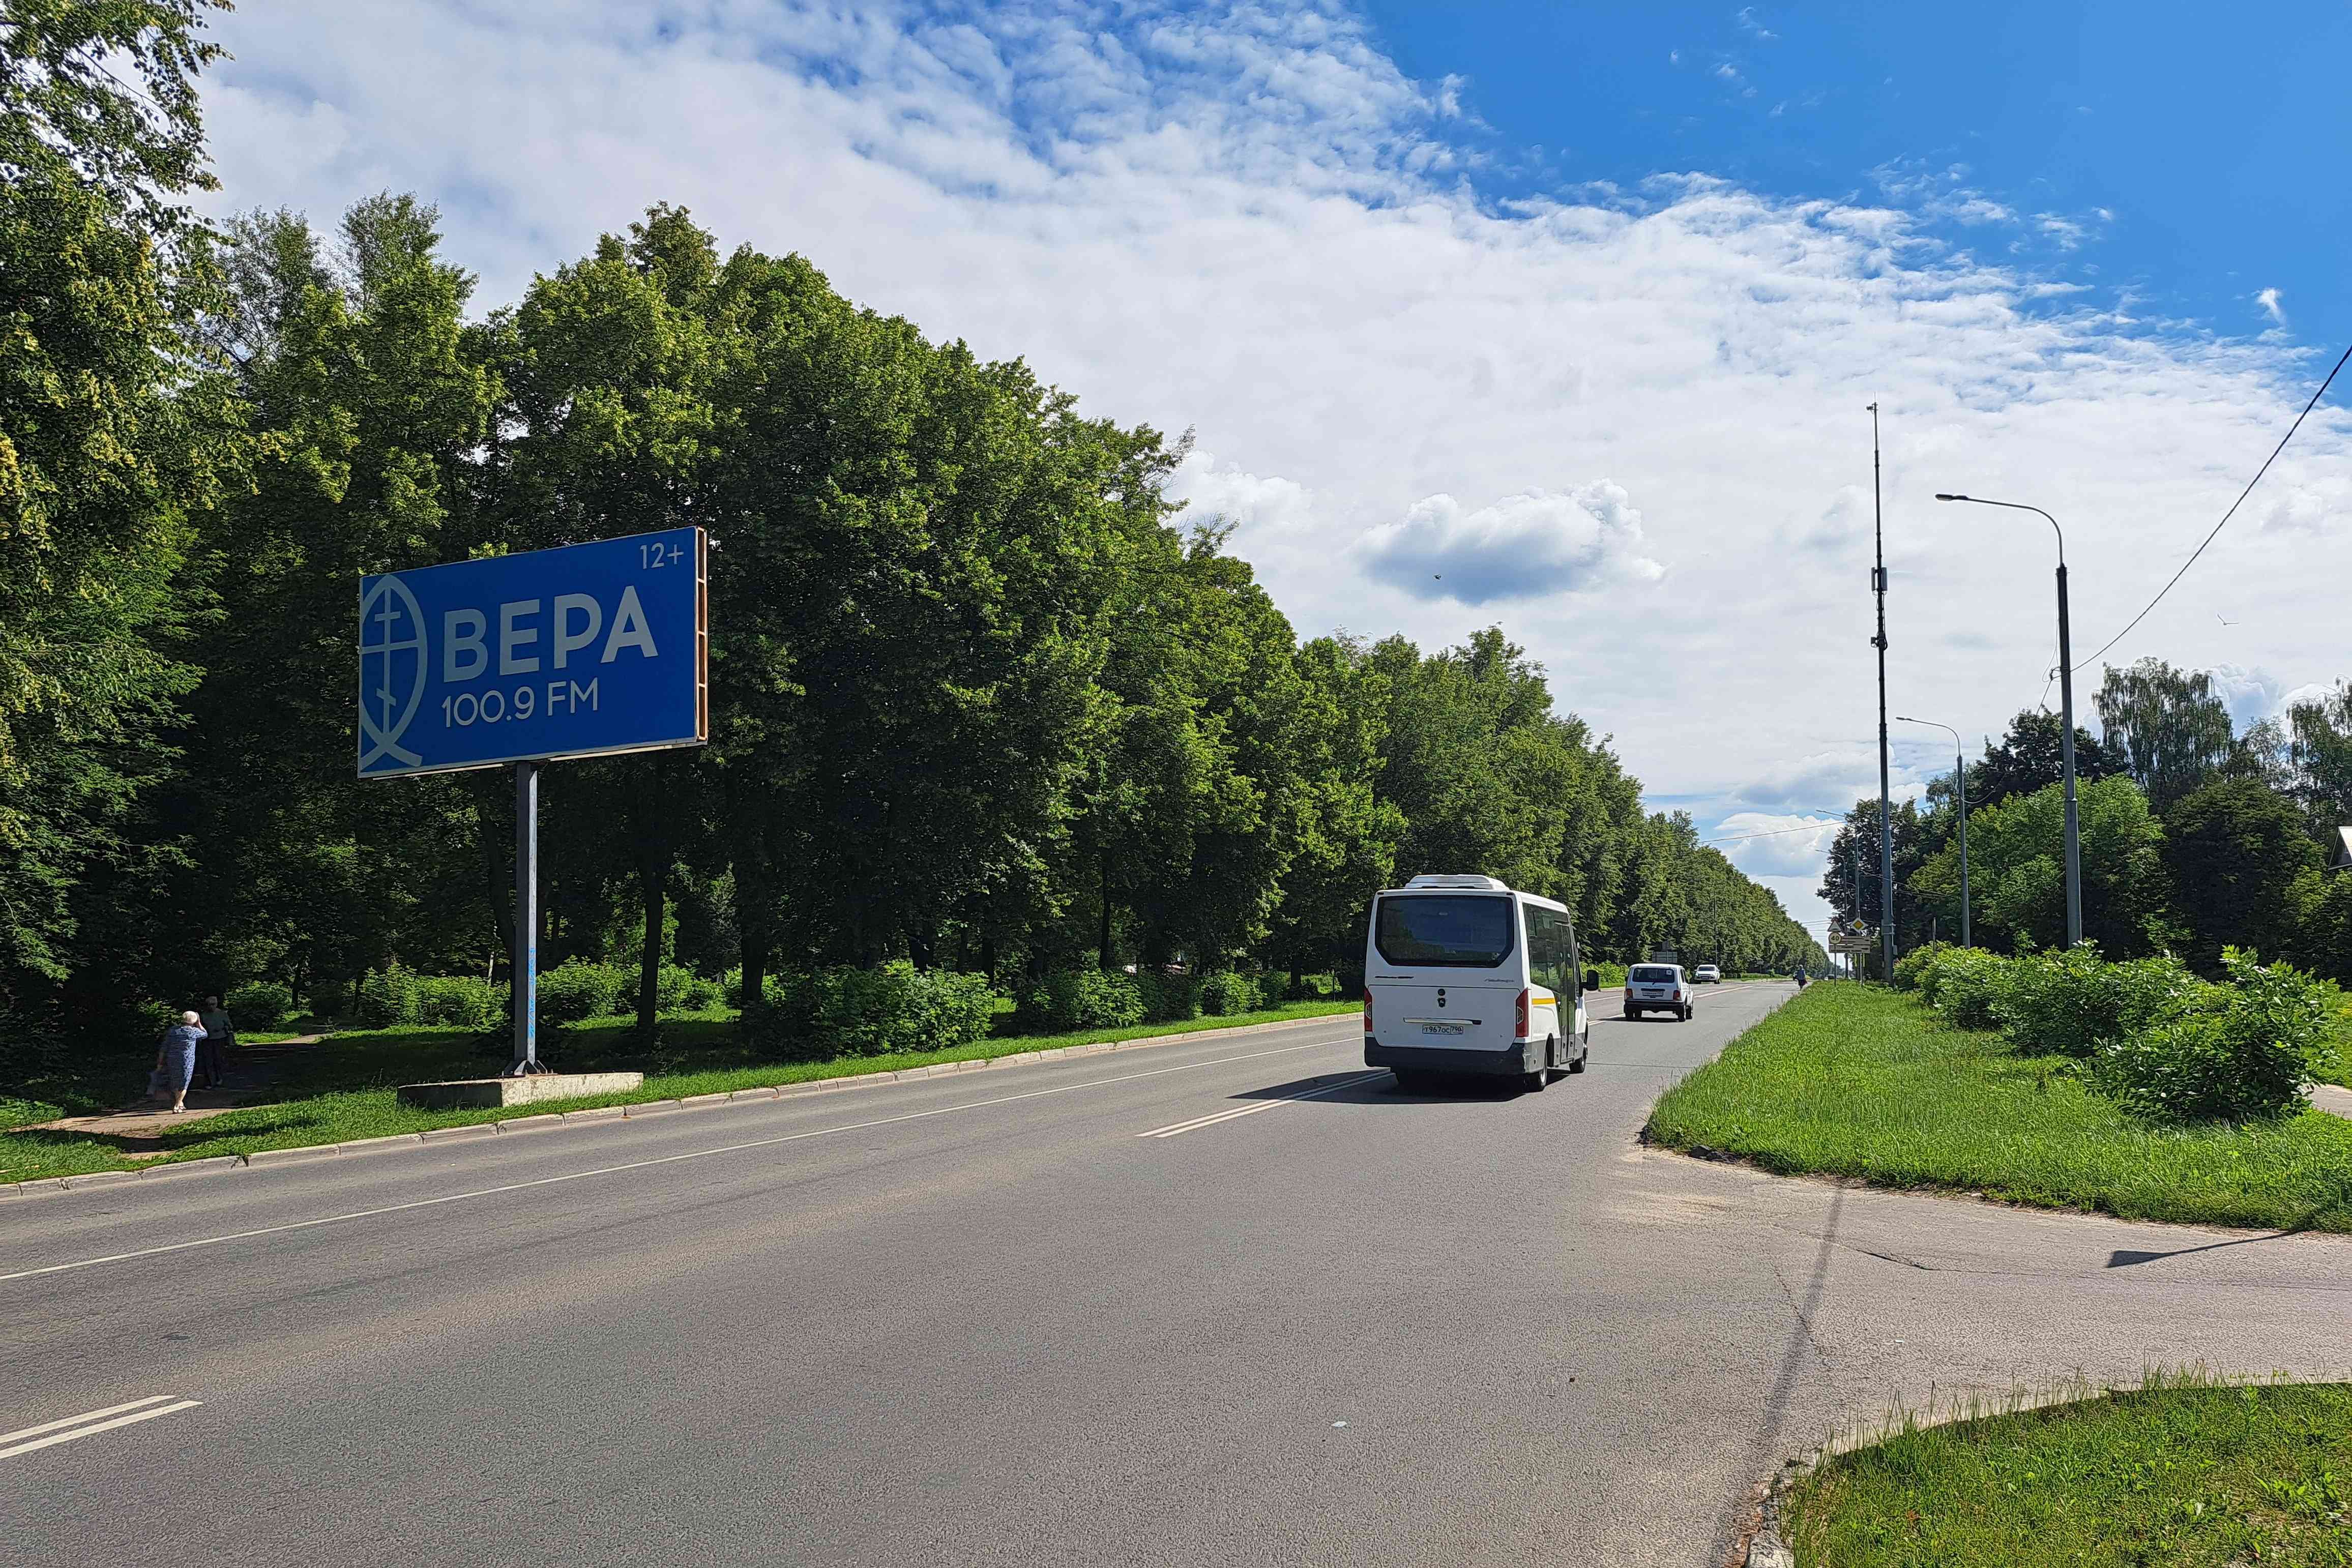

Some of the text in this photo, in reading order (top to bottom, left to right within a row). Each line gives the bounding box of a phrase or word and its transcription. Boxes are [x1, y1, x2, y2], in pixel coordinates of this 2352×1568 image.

[640, 542, 684, 570] 12+
[444, 585, 658, 683] ВЕРА
[441, 677, 599, 728] 100.9 FM
